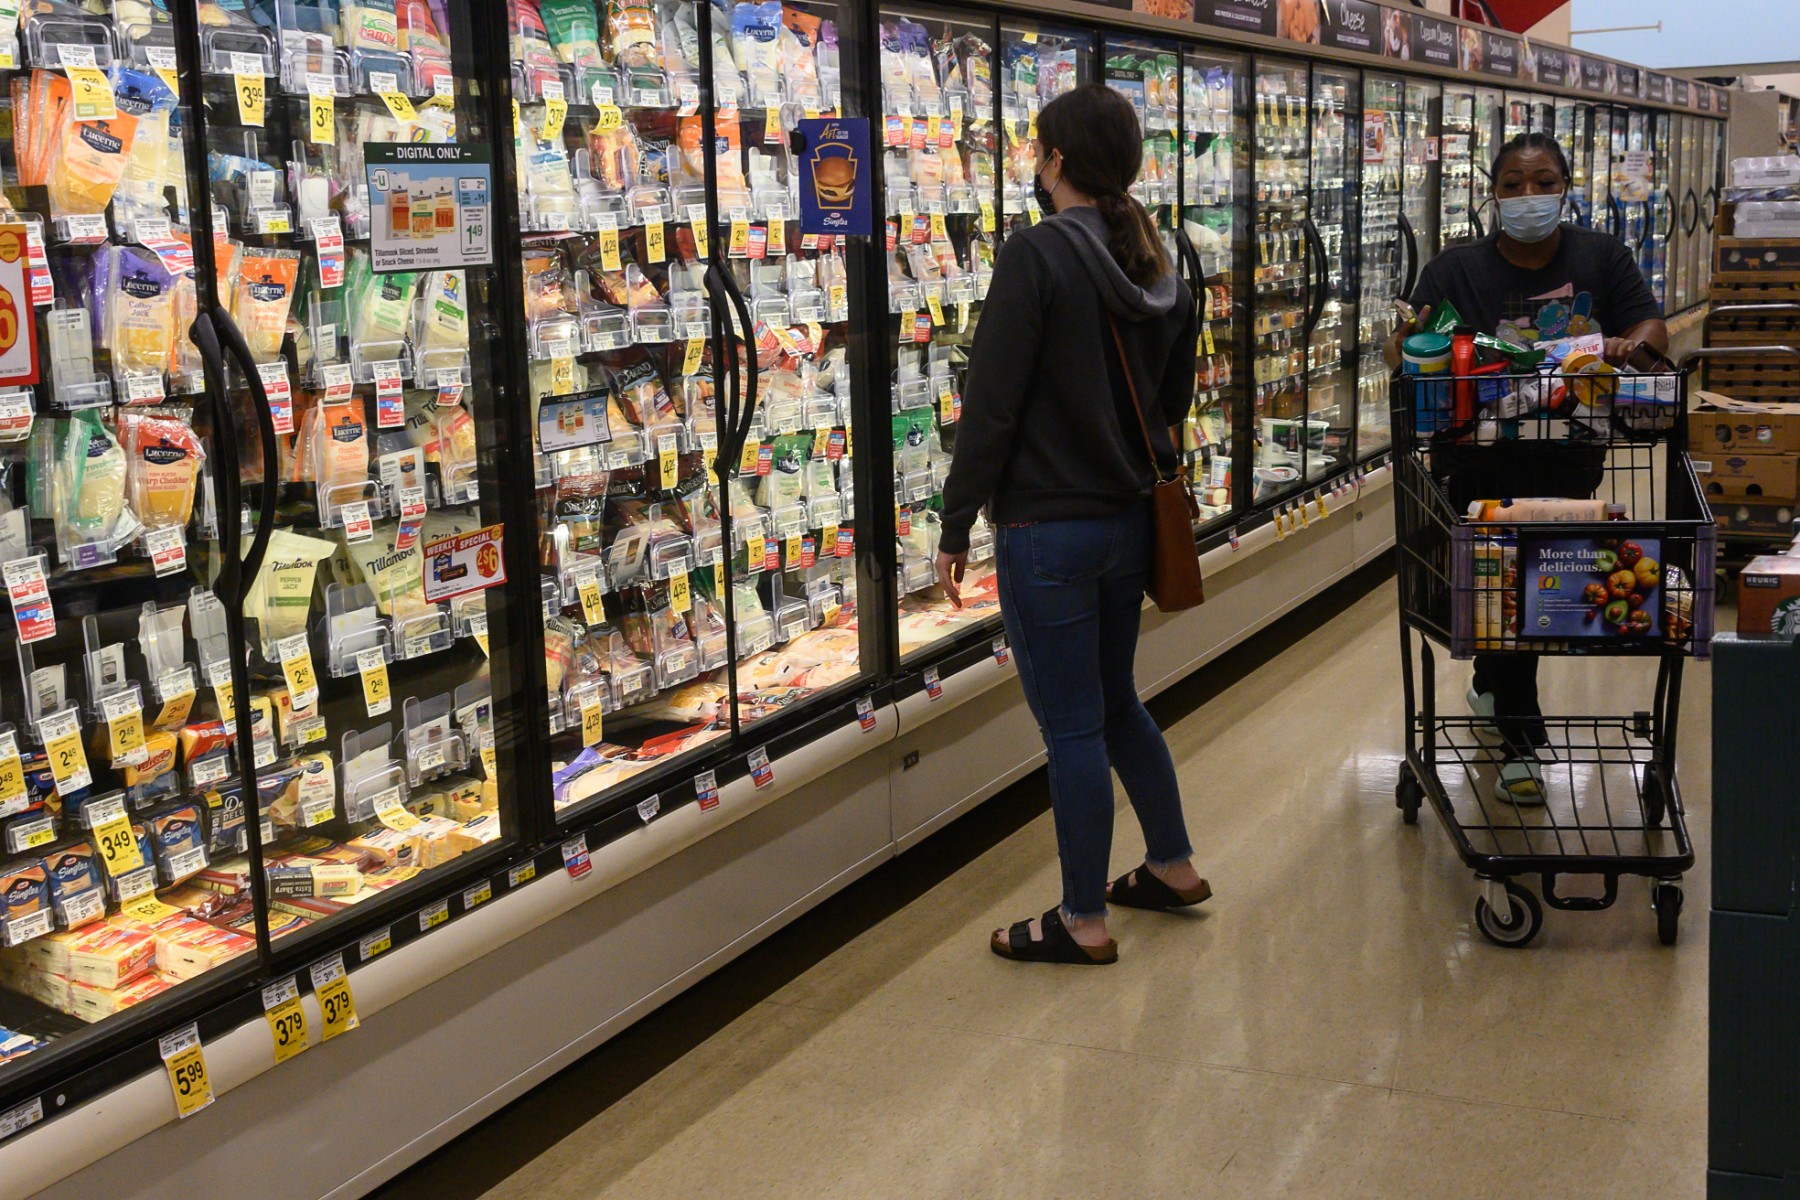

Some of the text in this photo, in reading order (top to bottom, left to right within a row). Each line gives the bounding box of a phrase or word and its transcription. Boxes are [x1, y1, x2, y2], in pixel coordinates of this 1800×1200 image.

[1341, 2, 1366, 33] Cheese
[1419, 20, 1453, 47] Cream Cheese
[243, 85, 263, 110] 399
[388, 94, 409, 112] 379
[316, 105, 333, 128] 379
[549, 108, 564, 128] 379
[603, 110, 619, 125] 379
[82, 126, 121, 150] Lucerne
[819, 123, 840, 140] Art
[396, 147, 461, 159] DIGITAL ONLY
[822, 217, 848, 228] Singles
[466, 224, 483, 245] 149
[649, 231, 662, 249] 429
[375, 249, 398, 257] Tillamook
[415, 247, 438, 255] Shredded
[602, 240, 617, 257] 429
[122, 278, 159, 292] Lucerne
[128, 301, 153, 311] Colby
[333, 427, 361, 437] Lucerne
[145, 447, 186, 458] Lucerne
[159, 476, 189, 485] Cheddar
[426, 532, 491, 556] WEEKLY SPECIAL
[154, 552, 167, 562] FREE
[1539, 548, 1607, 559] More than
[1538, 561, 1602, 573] delicious.
[279, 576, 302, 584] PEPPER
[1746, 576, 1778, 585] KEURIG
[13, 585, 27, 594] FREE
[673, 582, 687, 601] 429
[585, 592, 600, 610] 429
[294, 667, 308, 684] 249
[371, 678, 384, 694] 249
[169, 703, 186, 719] 249
[585, 712, 600, 733] 429
[119, 725, 135, 745] 249
[60, 747, 77, 767] 249
[223, 808, 245, 821] DELU
[164, 825, 192, 844] Singles
[102, 831, 131, 861] 349
[57, 861, 88, 879] Singles
[8, 886, 39, 904] Singles
[275, 885, 294, 895] Sharp
[294, 885, 312, 894] Extra
[324, 991, 350, 1025] 379
[275, 1012, 303, 1046] 379
[173, 1039, 186, 1052] 799
[176, 1060, 204, 1096] 599
